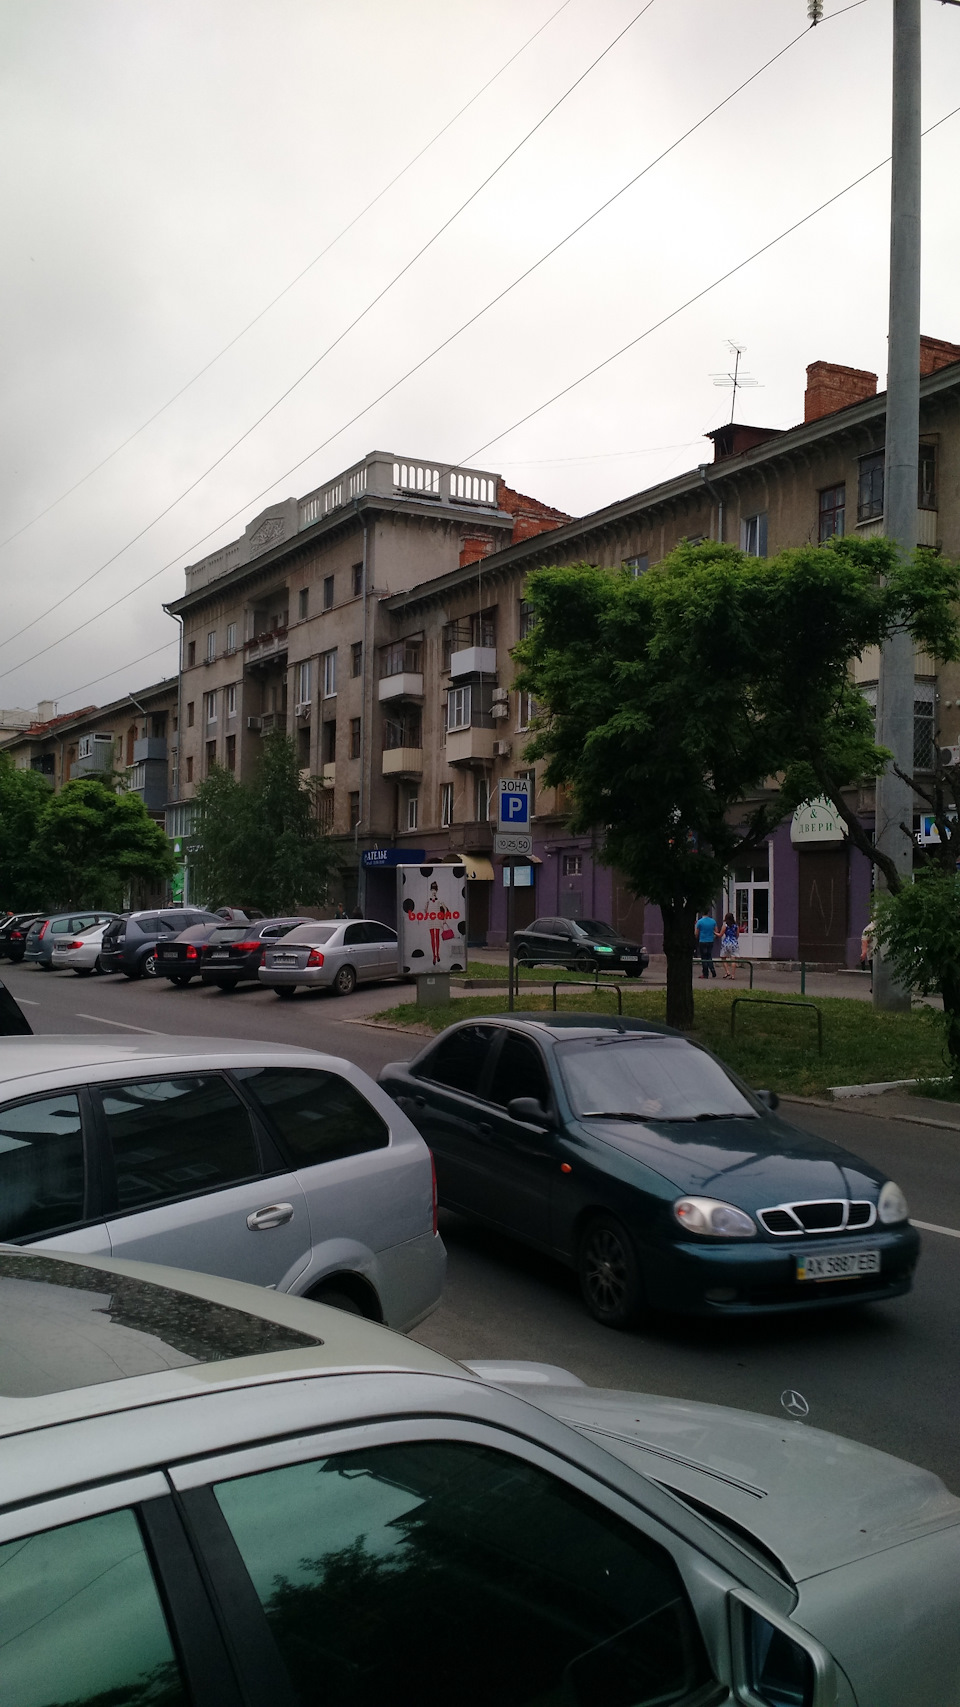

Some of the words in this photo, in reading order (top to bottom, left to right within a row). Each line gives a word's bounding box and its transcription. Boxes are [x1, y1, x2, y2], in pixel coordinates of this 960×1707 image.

[501, 781, 528, 791] ЗОНА
[509, 797, 523, 818] P
[799, 823, 832, 833] ДВЕРИ
[519, 840, 528, 848] 50
